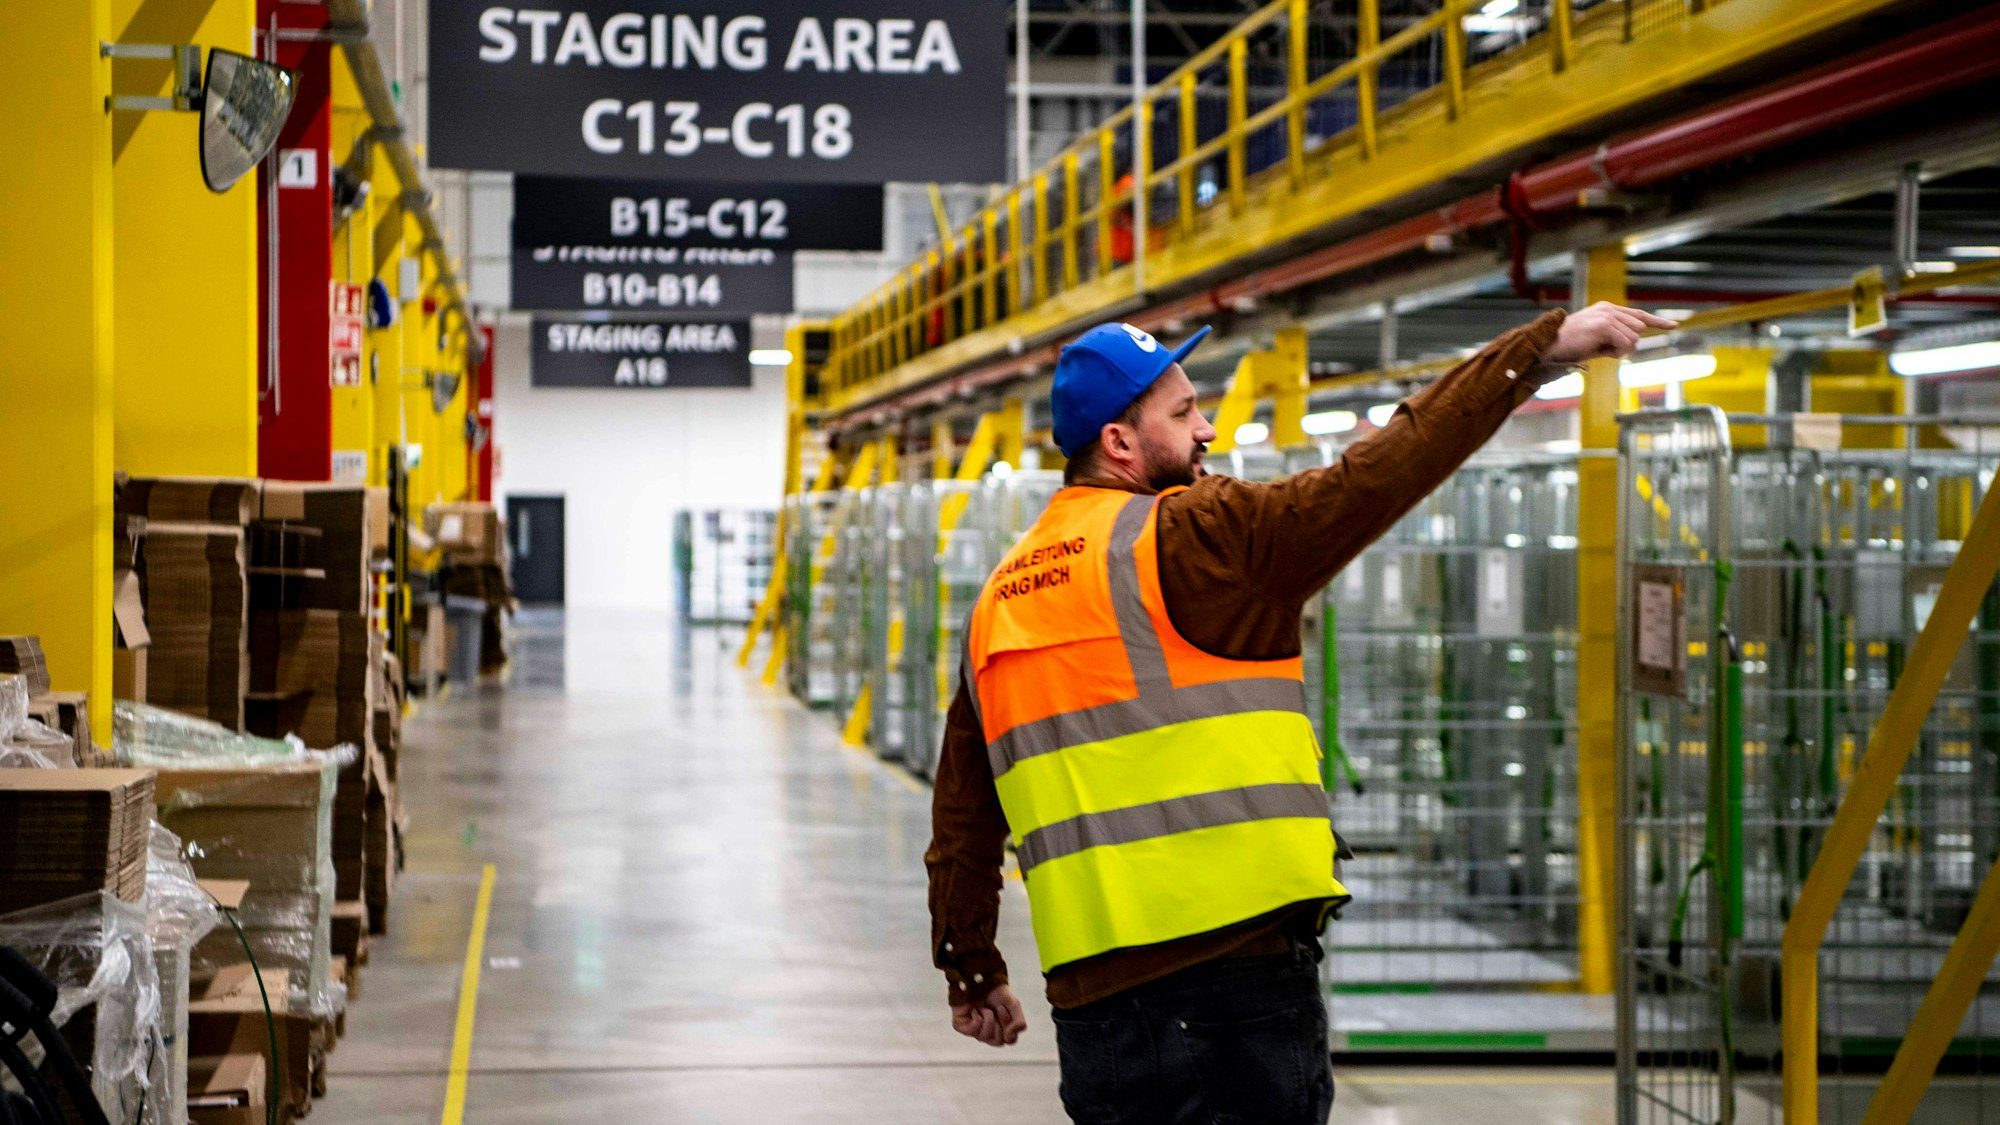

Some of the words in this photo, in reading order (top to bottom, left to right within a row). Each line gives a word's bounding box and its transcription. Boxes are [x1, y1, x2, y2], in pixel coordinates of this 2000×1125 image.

[478, 7, 768, 71] STAGING
[784, 17, 962, 74] AREA
[581, 98, 854, 160] C13-C18
[611, 198, 787, 238] B15-C12
[583, 272, 722, 307] B10-B14
[548, 323, 663, 352] STAGING
[665, 325, 738, 352] AREA
[1034, 566, 1070, 592] MICH
